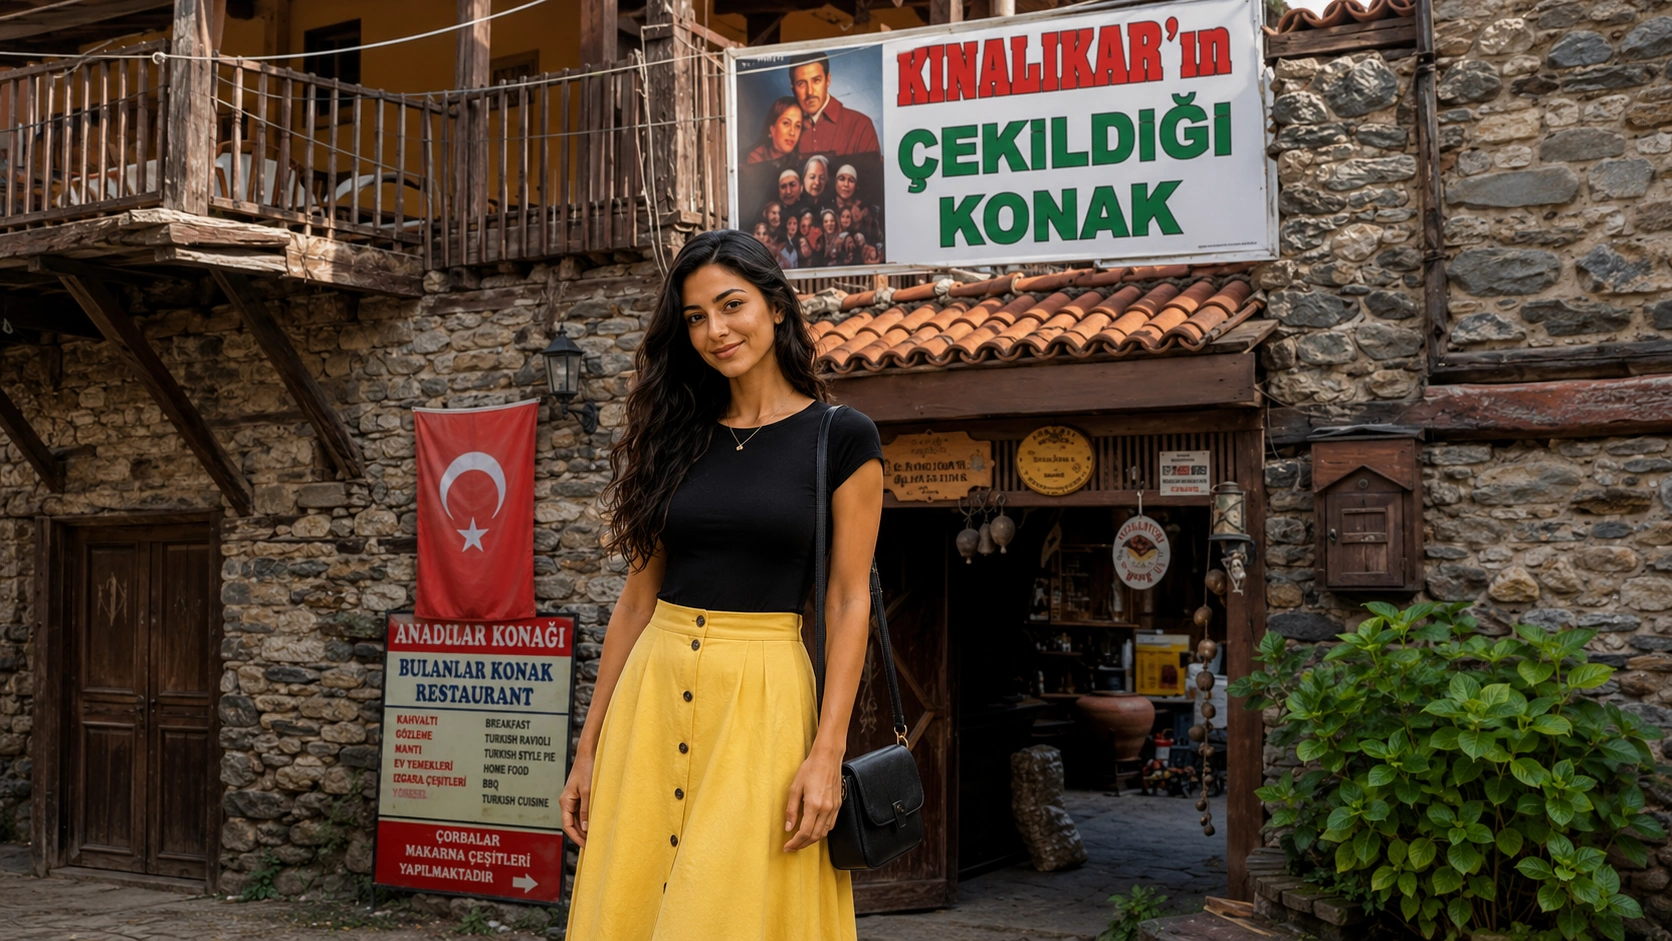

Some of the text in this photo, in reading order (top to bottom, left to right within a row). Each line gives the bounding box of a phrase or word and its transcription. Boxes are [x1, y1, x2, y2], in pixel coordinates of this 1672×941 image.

[939, 179, 1184, 248] KONAK
[491, 621, 566, 648] KONAĞI
[399, 658, 554, 682] BULANLAR KONAK
[415, 683, 534, 706] RESTAURANT
[396, 714, 438, 726] KAHVALTI
[485, 718, 531, 730] BREAKFAST
[484, 733, 551, 747] TURKISH RAVIOLI
[394, 744, 422, 755] MANTI
[484, 748, 556, 762] TURKISH STYLE PIE
[393, 758, 406, 769] EV
[483, 763, 529, 776] HOME FOOD
[482, 778, 499, 791] BBQ
[482, 794, 550, 808] TURKISH CUISINE
[435, 829, 500, 847] ÇORBALAR
[405, 844, 531, 868] MAKARNA ÇEŞİTLERİ
[399, 862, 494, 884] YAPILMAKTADIR
